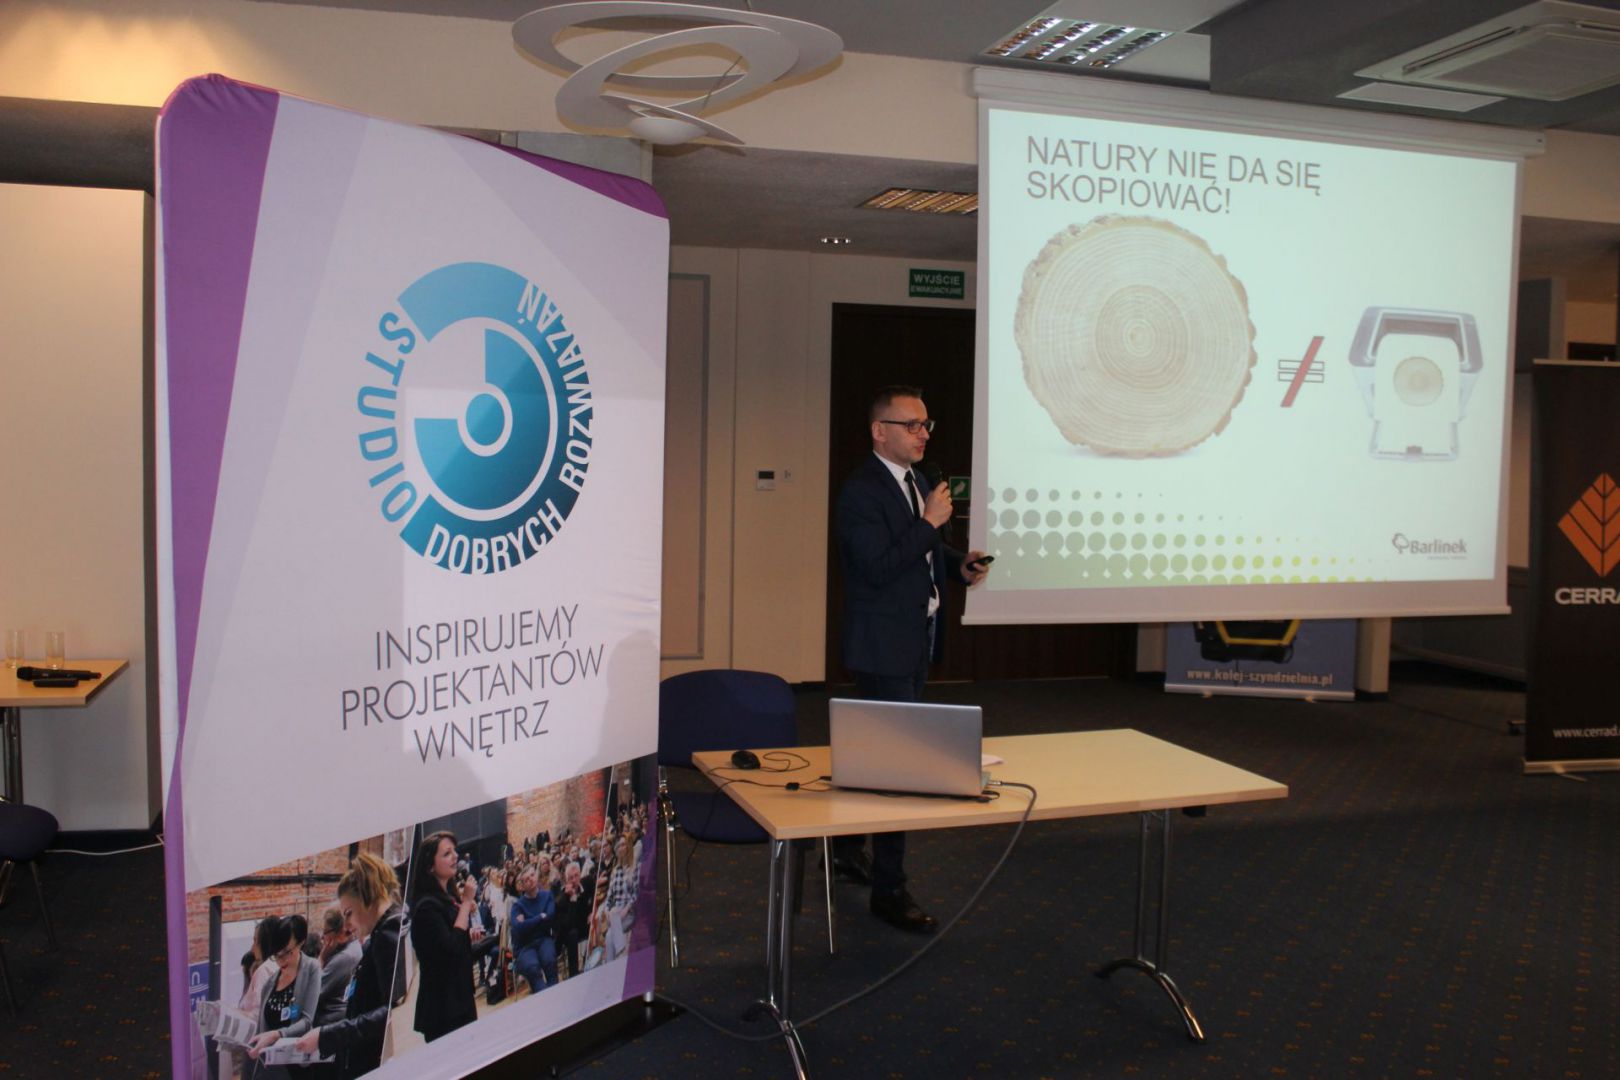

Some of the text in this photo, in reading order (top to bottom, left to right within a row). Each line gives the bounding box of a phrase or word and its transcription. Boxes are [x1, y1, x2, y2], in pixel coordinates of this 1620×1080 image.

[1027, 135, 1321, 196] NATURY NIE DA SIĘ
[1026, 170, 1232, 214] SKOPIOWAĆ!
[913, 273, 961, 286] WYJŚCIE
[357, 311, 418, 523] STUDIO
[423, 498, 566, 576] DOBRYCH
[1410, 538, 1468, 554] Barlinek
[1555, 587, 1620, 605] CERR
[375, 603, 579, 672] INSPIRUJEMY
[341, 640, 605, 731] PROJEKTANTÓW
[1186, 668, 1334, 686] www.kolej-szyndzielnia.pl
[413, 699, 550, 765] WNĘTRZ
